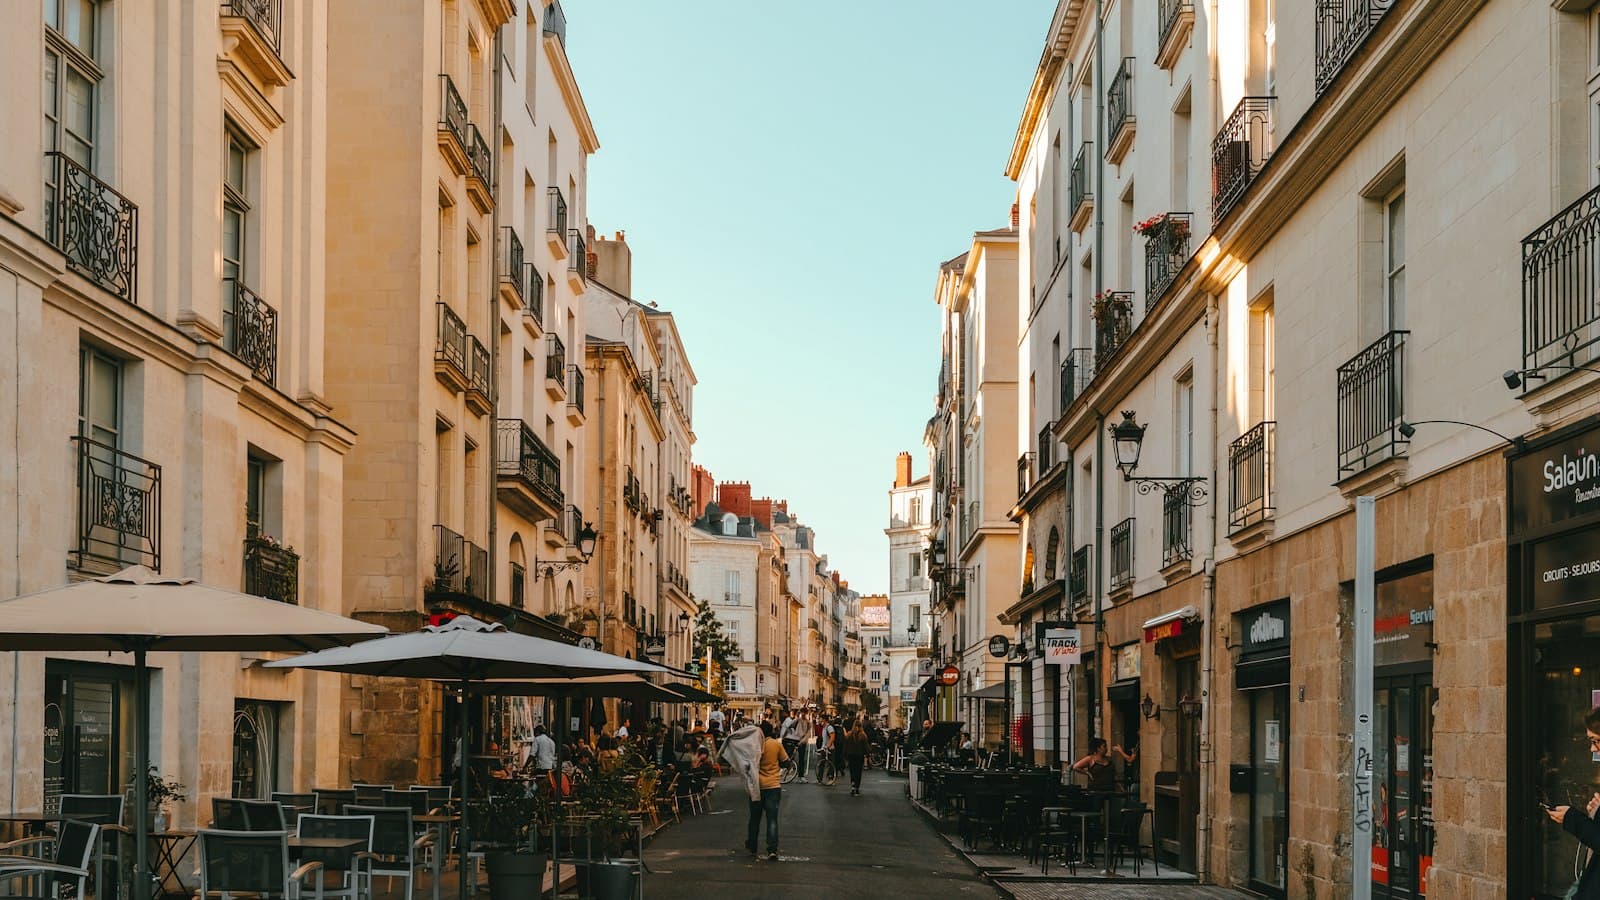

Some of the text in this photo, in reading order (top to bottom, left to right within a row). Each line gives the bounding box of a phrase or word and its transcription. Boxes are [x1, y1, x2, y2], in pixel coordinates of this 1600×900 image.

[1543, 447, 1597, 492] Salaün
[1543, 560, 1600, 582] CIRCUITS SEJOURS
[1410, 606, 1434, 625] Servi
[1046, 636, 1077, 648] TRACK
